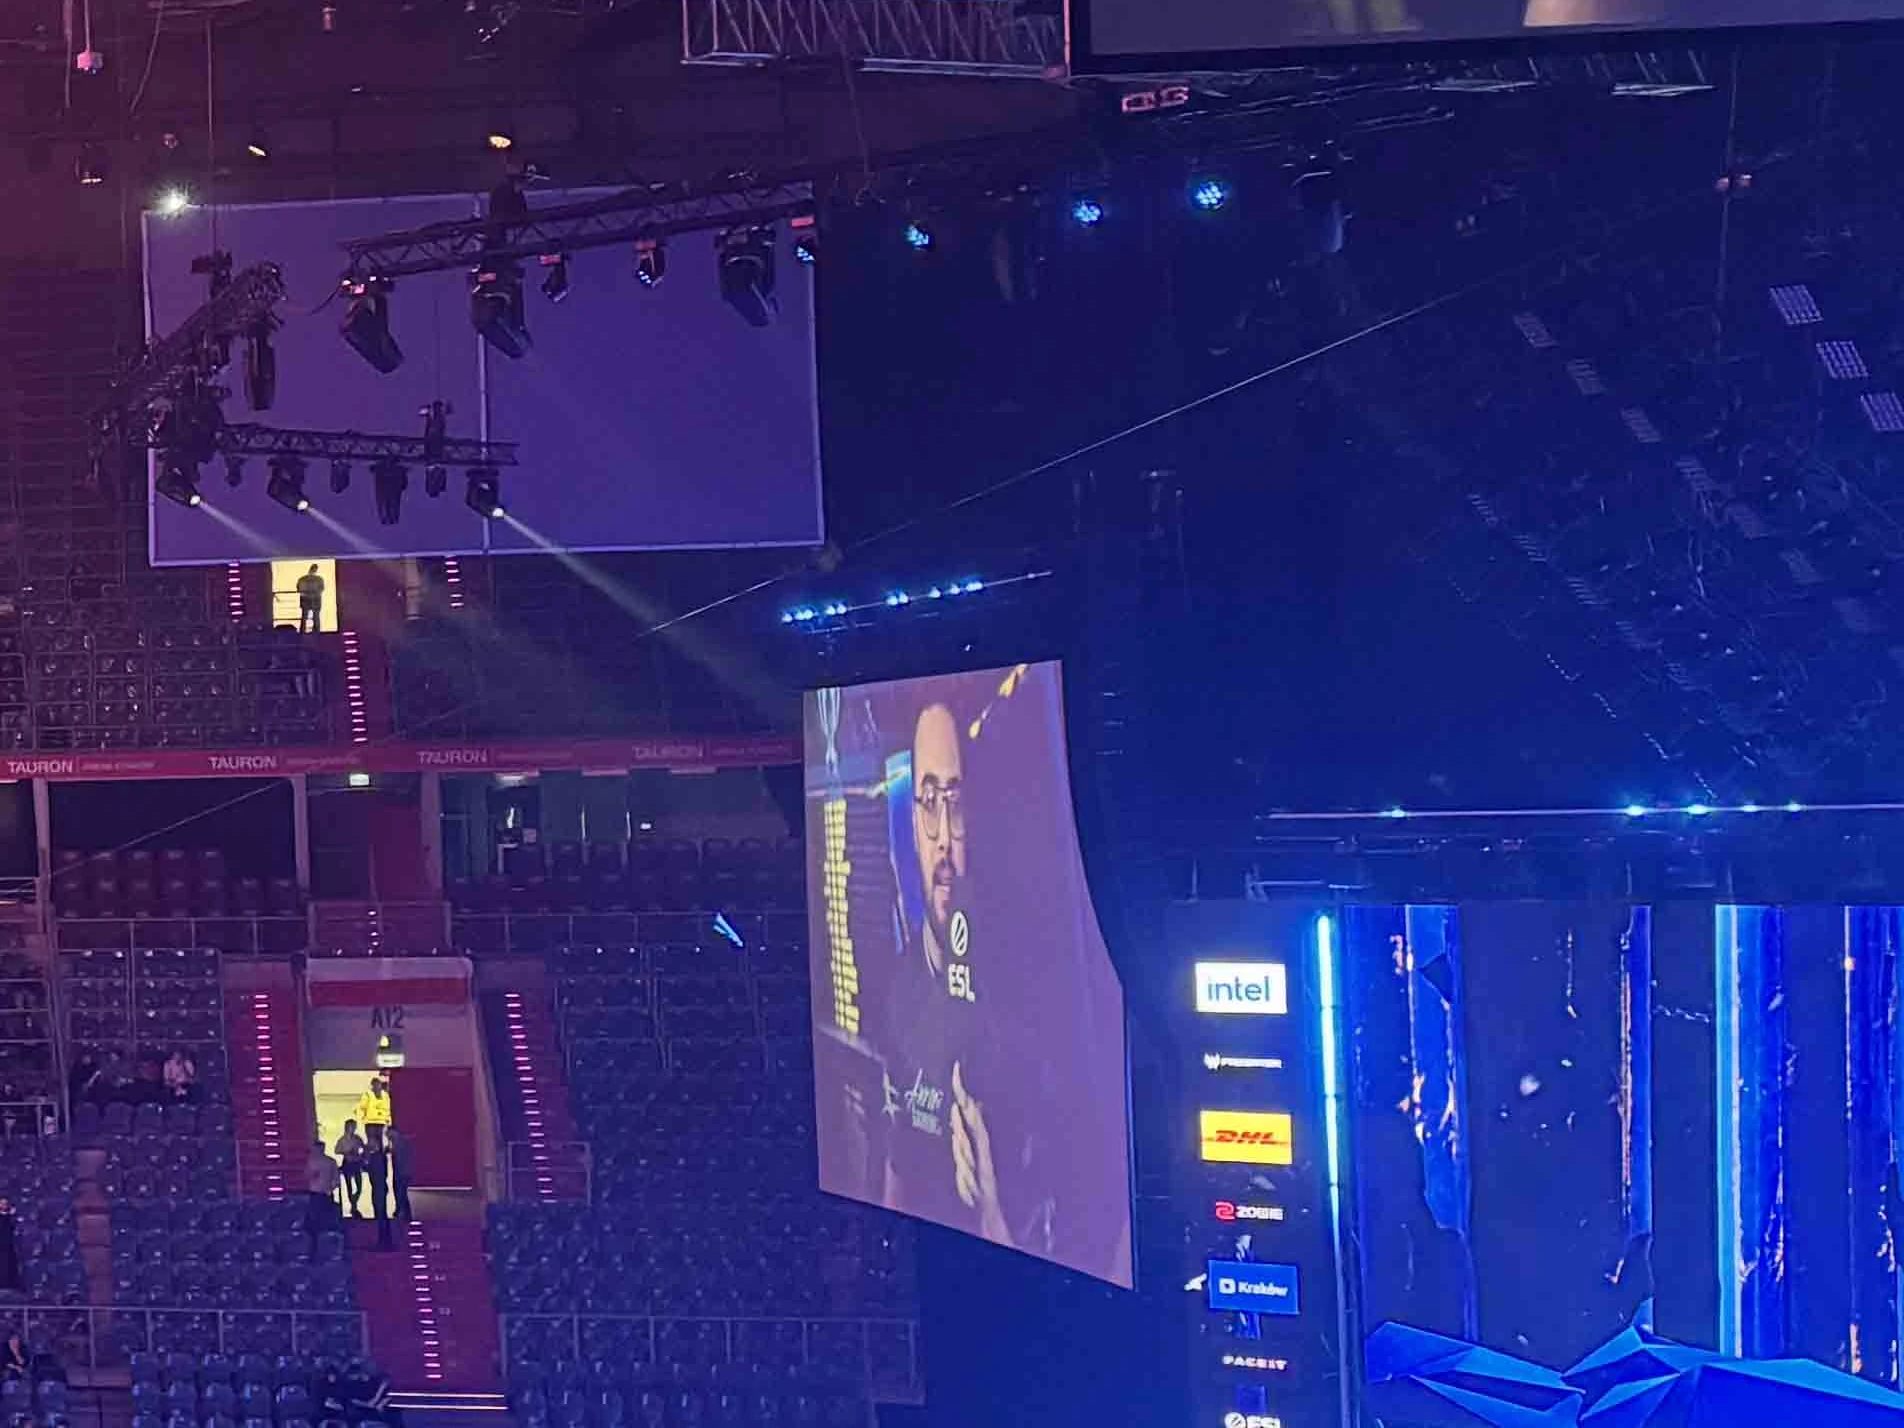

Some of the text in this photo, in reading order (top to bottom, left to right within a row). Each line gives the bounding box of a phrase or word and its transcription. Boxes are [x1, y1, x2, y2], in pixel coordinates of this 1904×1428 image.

[208, 755, 277, 770] TAURON
[416, 750, 486, 764] TAURON
[7, 759, 72, 774] TAURON
[948, 963, 976, 1003] ESL
[1208, 976, 1270, 1001] intel
[371, 1006, 404, 1029] A12
[1215, 1129, 1276, 1146] DHL
